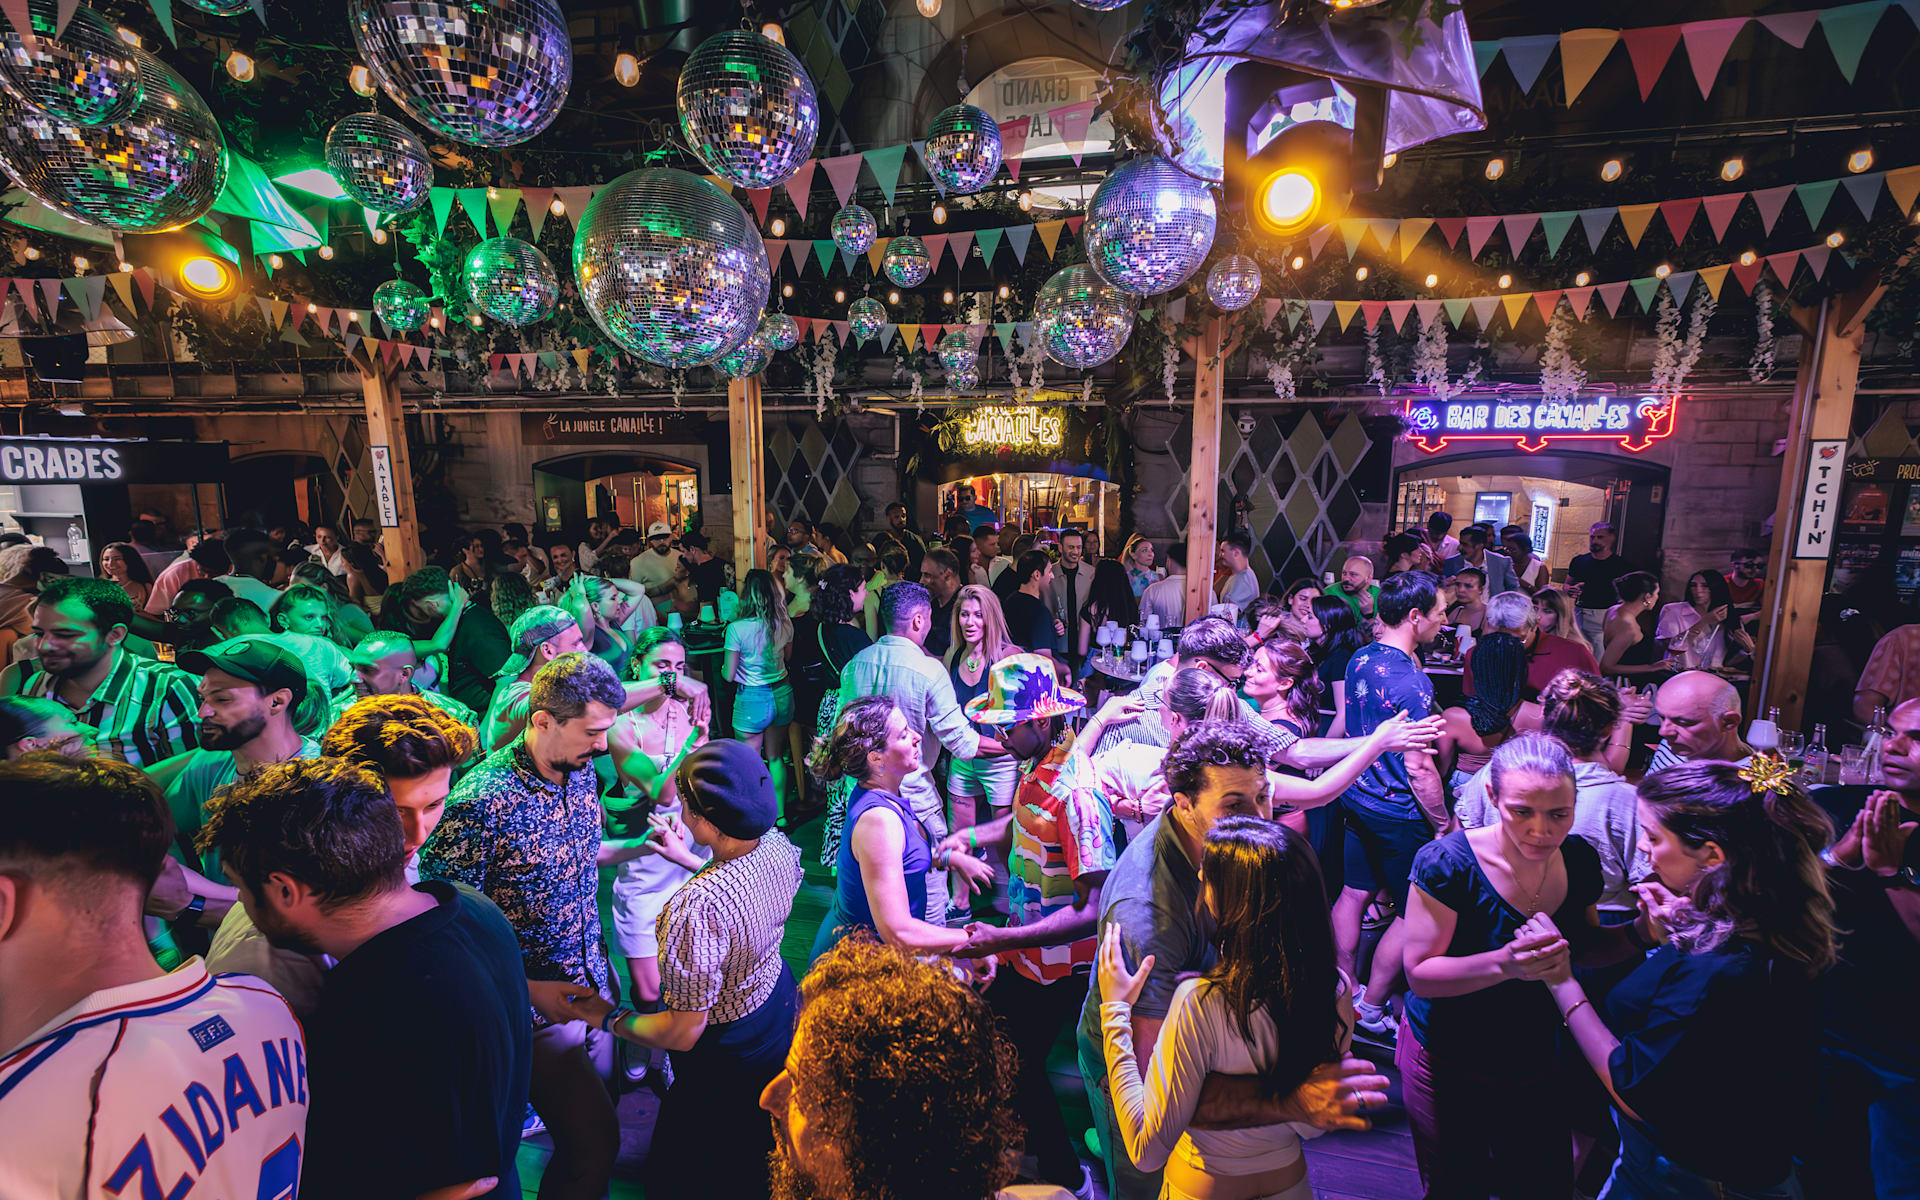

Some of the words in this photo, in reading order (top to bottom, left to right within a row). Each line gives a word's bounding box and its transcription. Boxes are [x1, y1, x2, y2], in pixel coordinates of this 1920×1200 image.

[559, 420, 571, 433] LA
[572, 420, 606, 433] JUNGLE
[1447, 404, 1488, 429] BAR
[1494, 404, 1531, 428] DES
[1, 446, 122, 480] CRABES
[102, 1037, 307, 1200] ZIDANE
